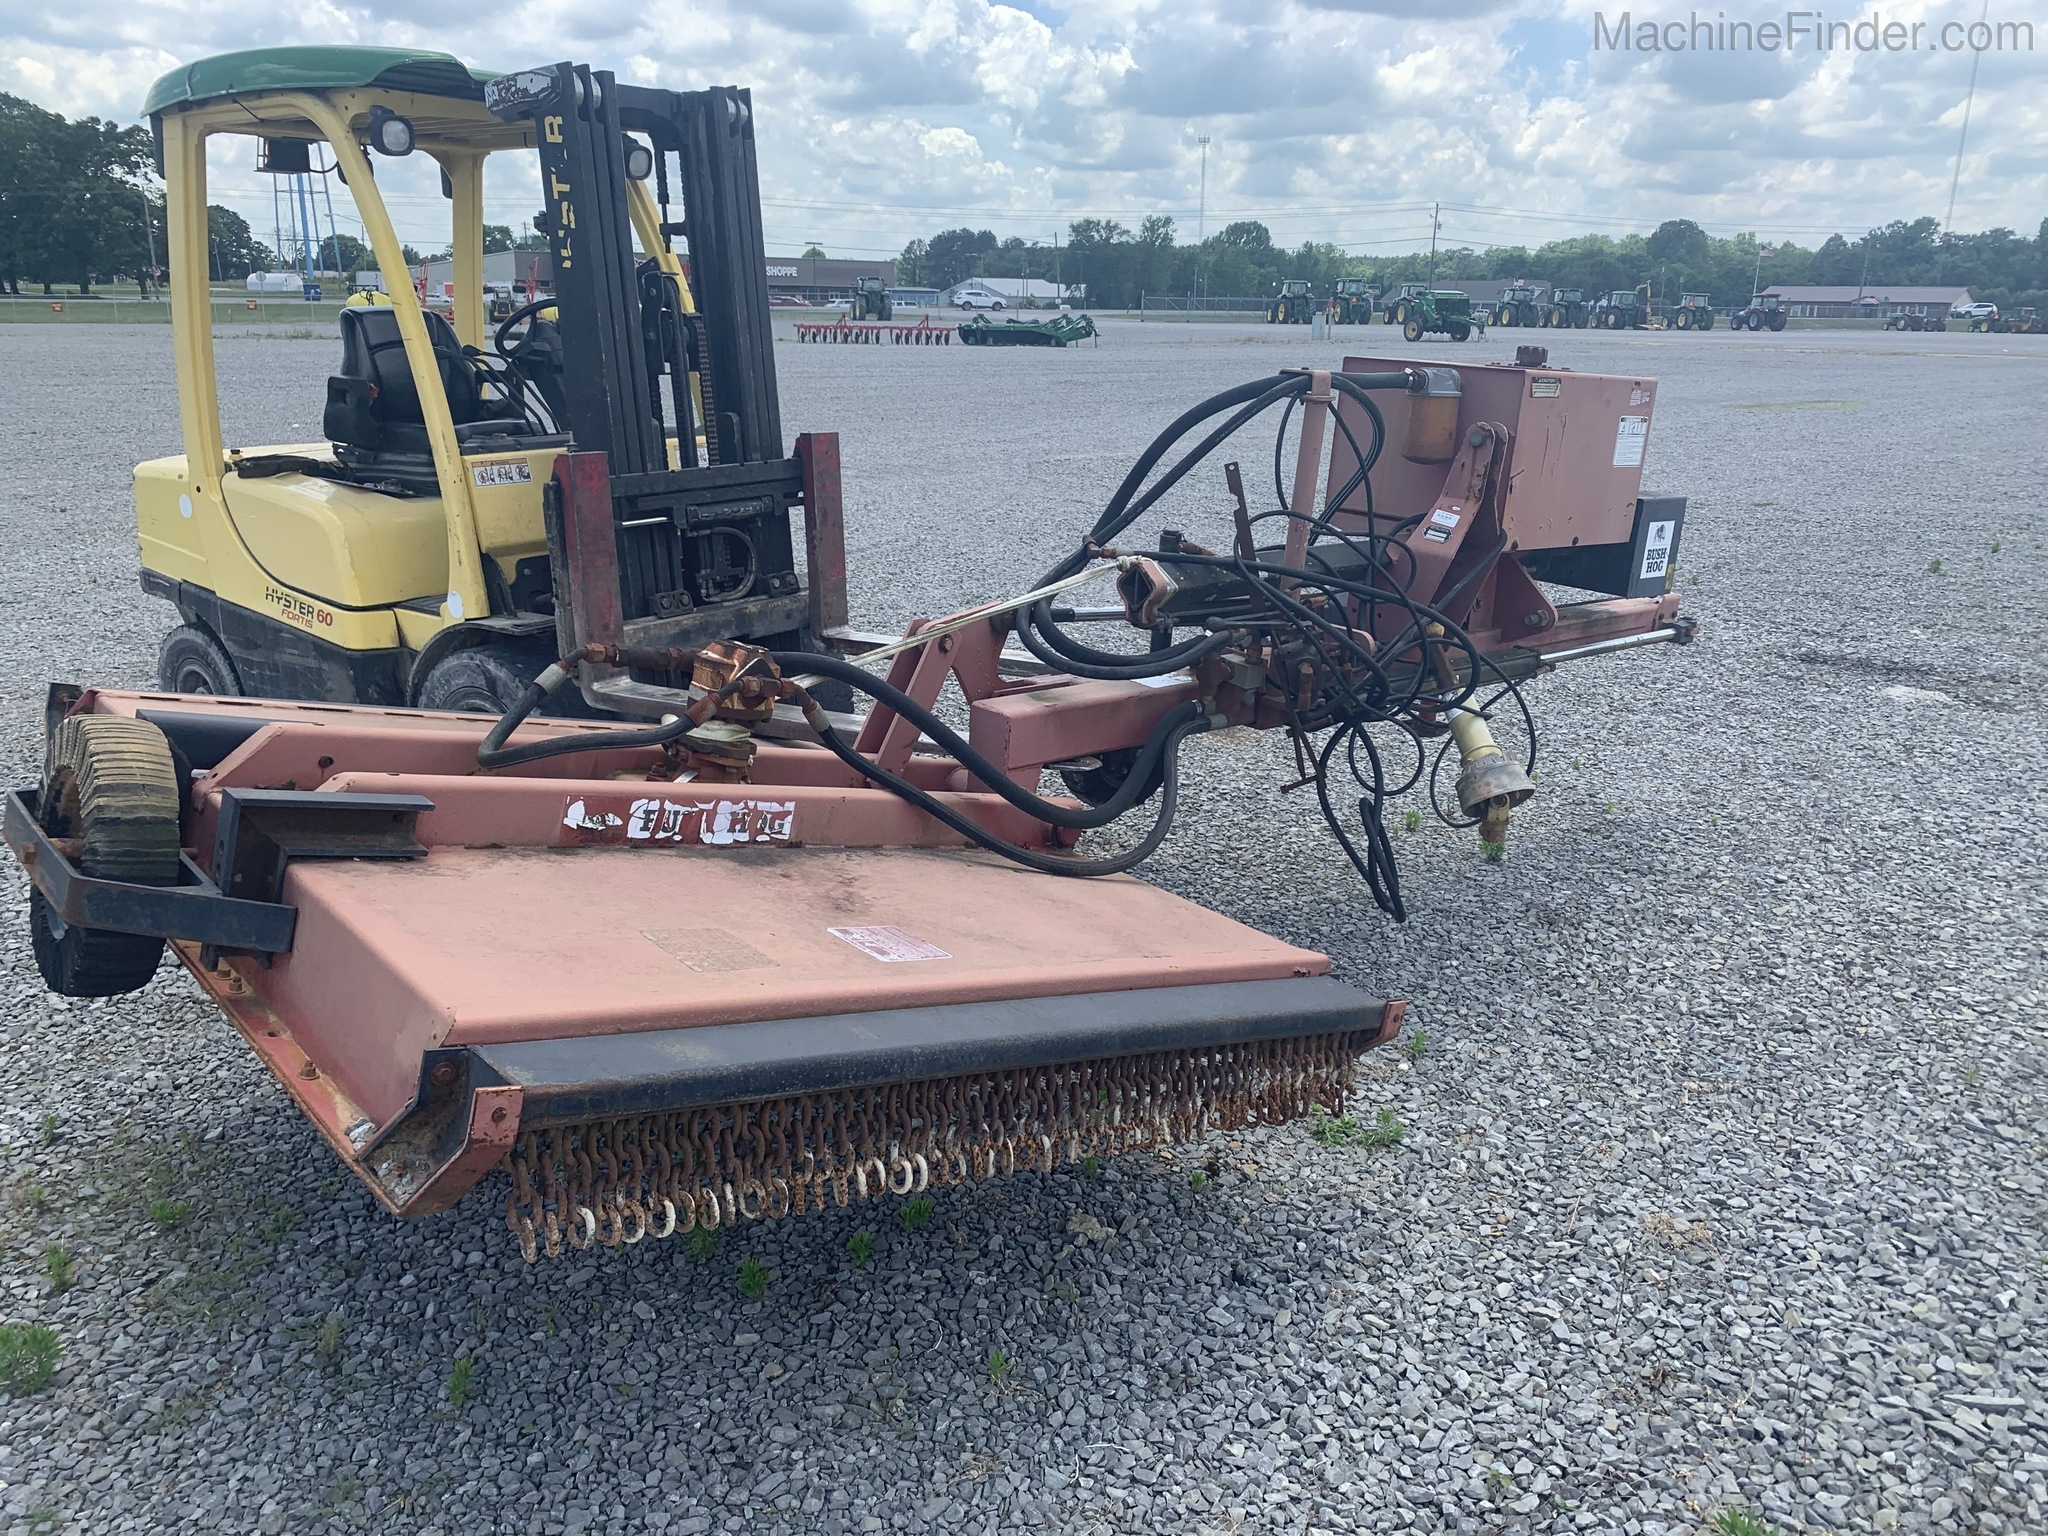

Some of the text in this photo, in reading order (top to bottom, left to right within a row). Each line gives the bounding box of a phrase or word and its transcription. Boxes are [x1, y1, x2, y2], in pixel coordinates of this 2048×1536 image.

[766, 266, 798, 277] SHOPPE
[1646, 548, 1667, 560] BUSH
[1646, 561, 1664, 573] HOG
[265, 586, 333, 627] HYSTER 60
[281, 608, 314, 629] FORTIS
